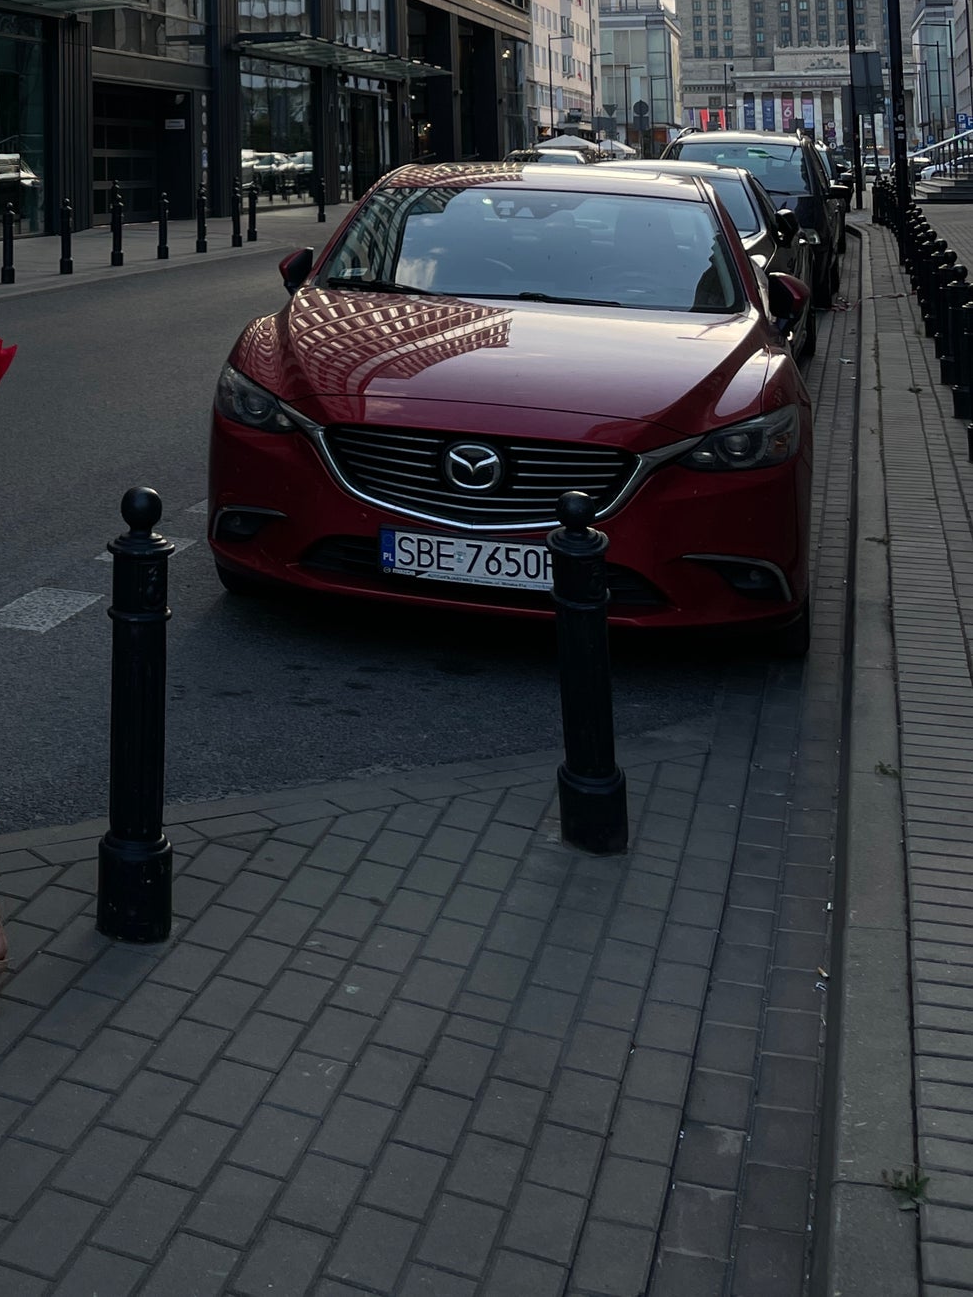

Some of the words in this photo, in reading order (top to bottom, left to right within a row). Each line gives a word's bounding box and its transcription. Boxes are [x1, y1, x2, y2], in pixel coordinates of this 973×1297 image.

[784, 106, 792, 117] 6
[958, 114, 965, 122] P
[382, 552, 394, 563] PL
[398, 536, 454, 571] SBE
